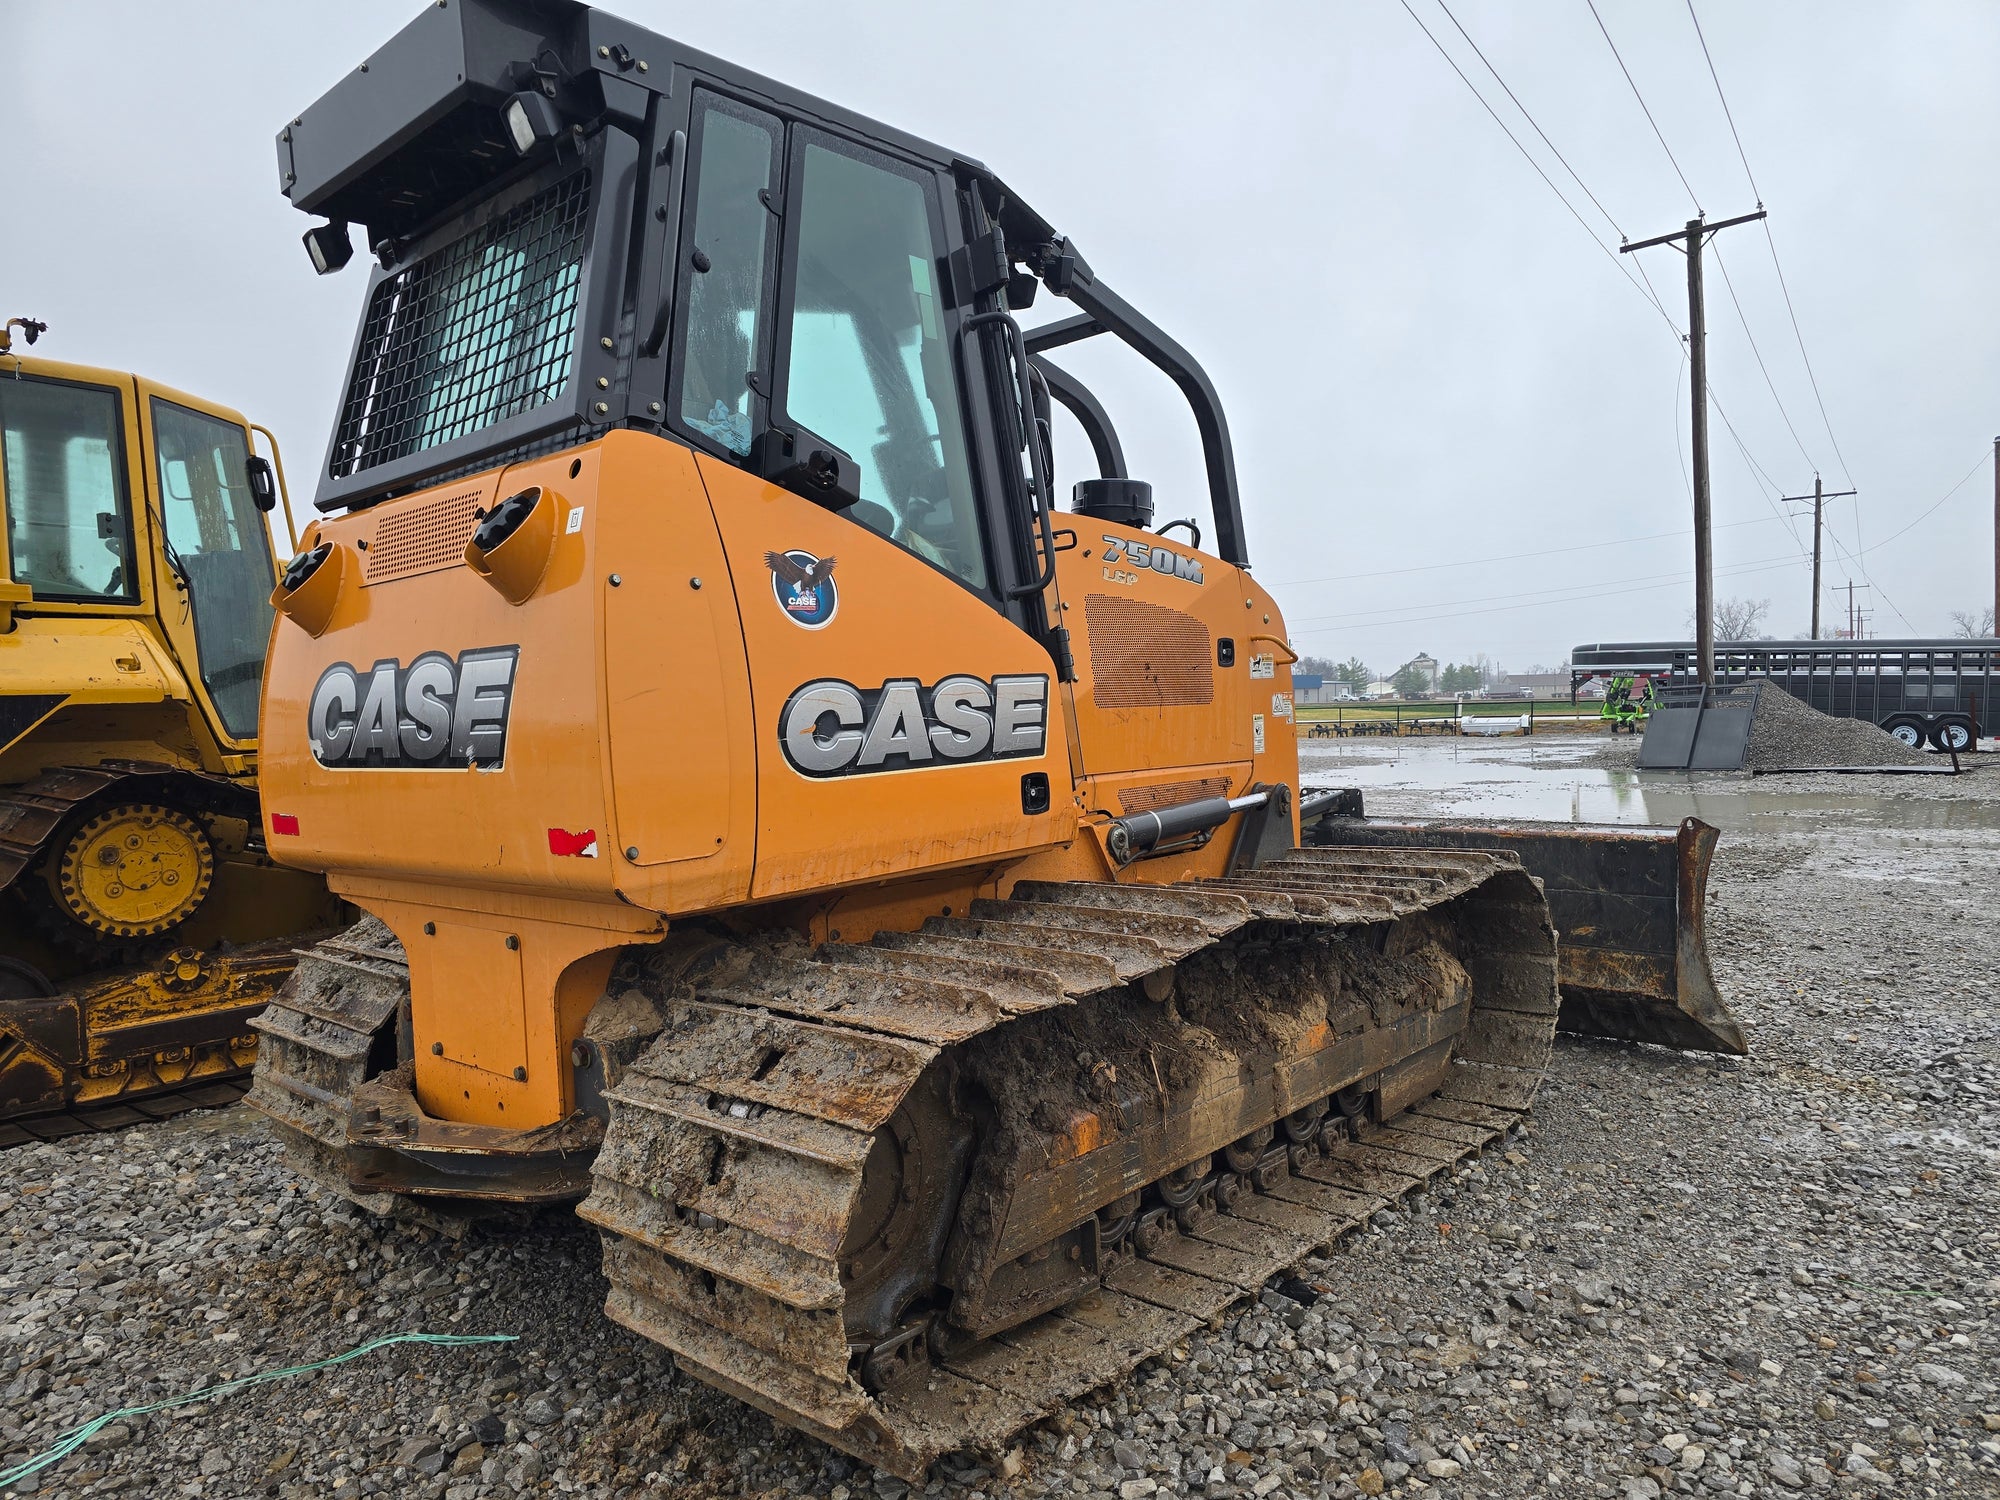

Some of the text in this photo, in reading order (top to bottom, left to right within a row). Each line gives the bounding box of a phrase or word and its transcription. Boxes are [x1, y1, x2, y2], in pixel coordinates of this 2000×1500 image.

[1102, 534, 1203, 585] 750M
[788, 597, 817, 606] CASE
[310, 652, 515, 762] CASE
[782, 677, 1047, 774] CASE
